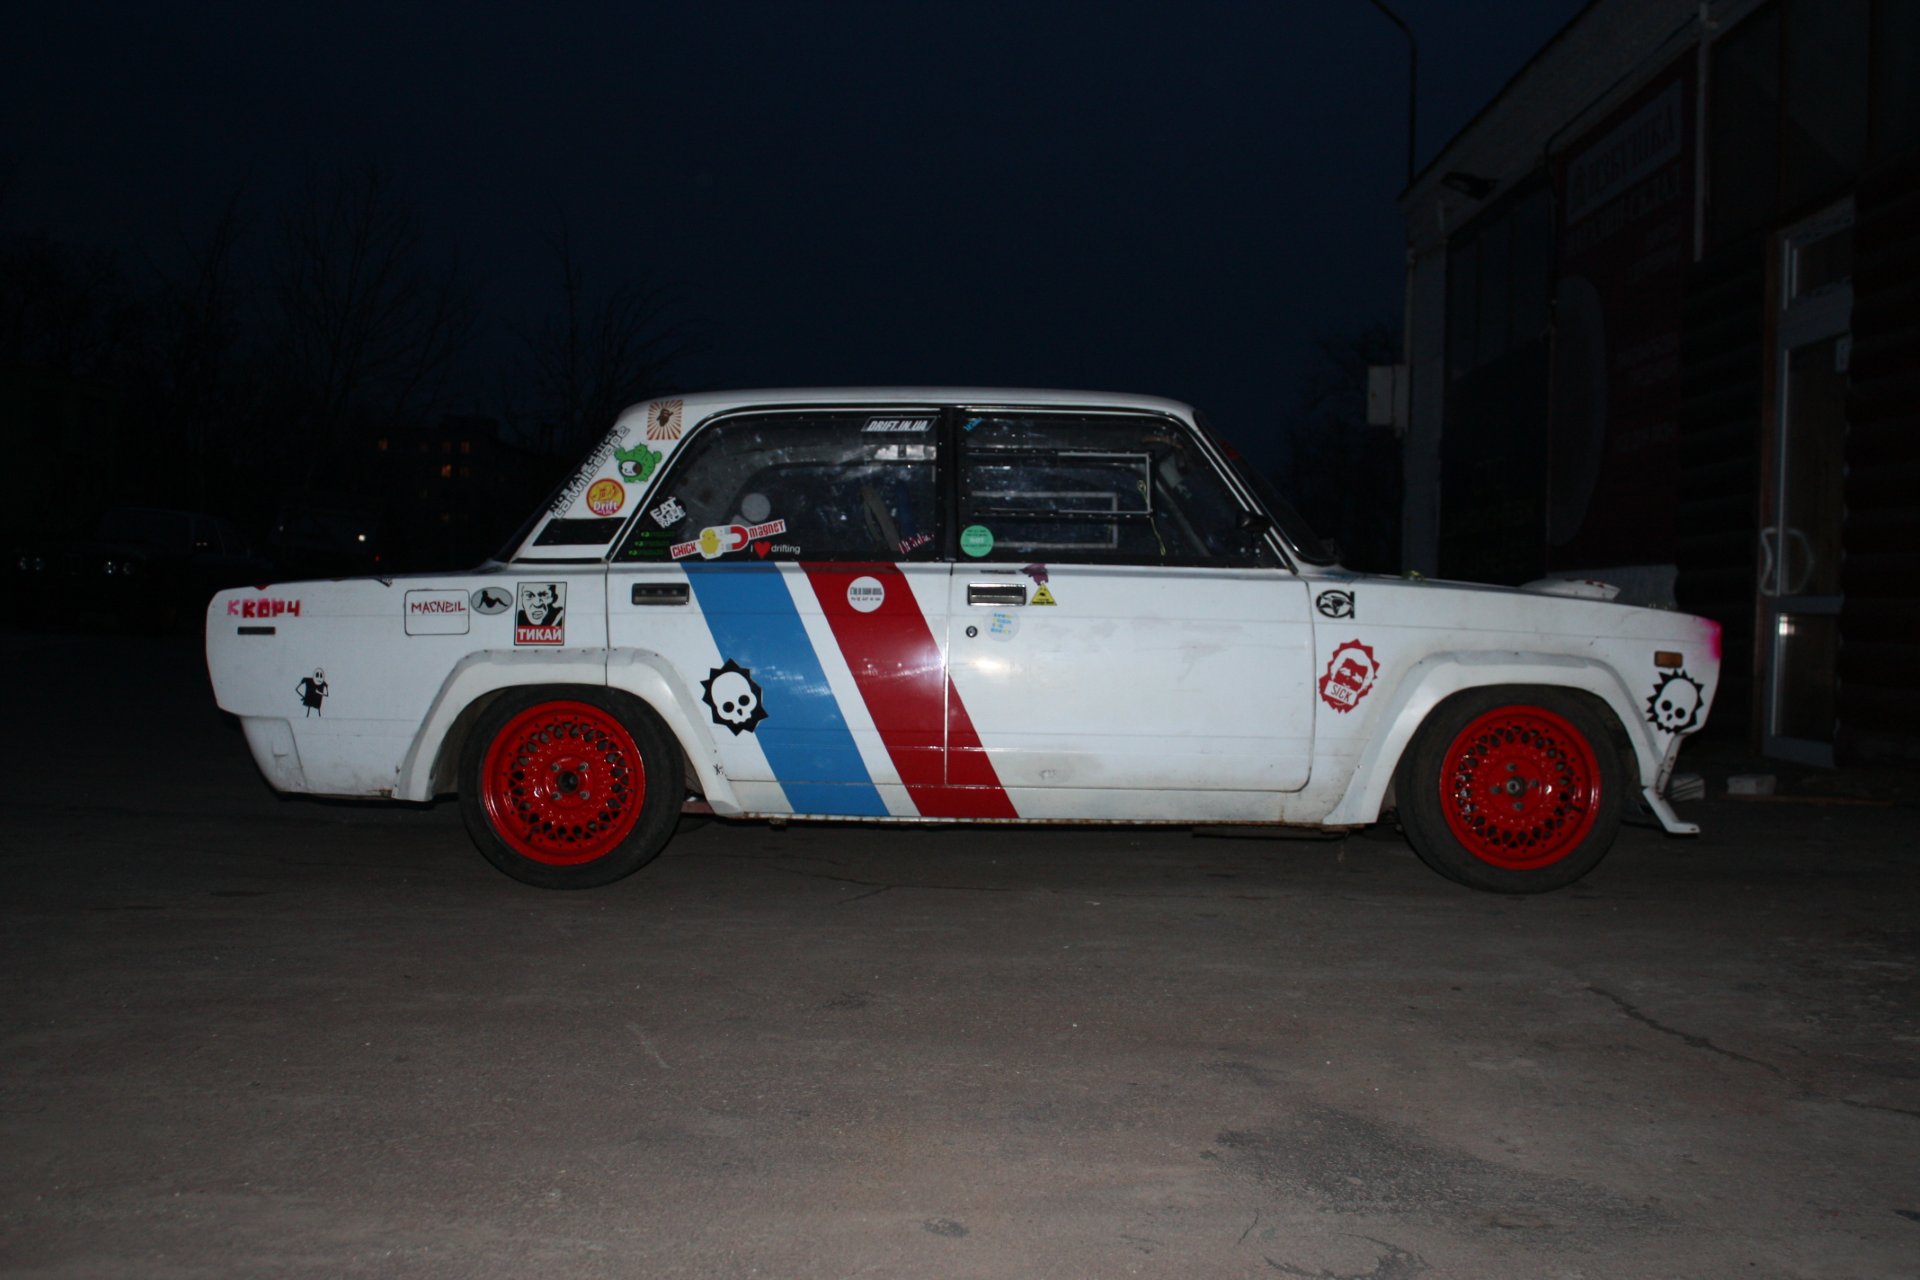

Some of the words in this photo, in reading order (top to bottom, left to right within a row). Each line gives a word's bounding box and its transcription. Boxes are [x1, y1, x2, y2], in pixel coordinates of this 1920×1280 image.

[866, 419, 928, 432] DRIFT.IN.UA
[593, 500, 617, 512] Drift
[771, 544, 801, 554] drifting
[518, 626, 562, 641] ТИКАЙ
[1331, 684, 1352, 702] SICK
